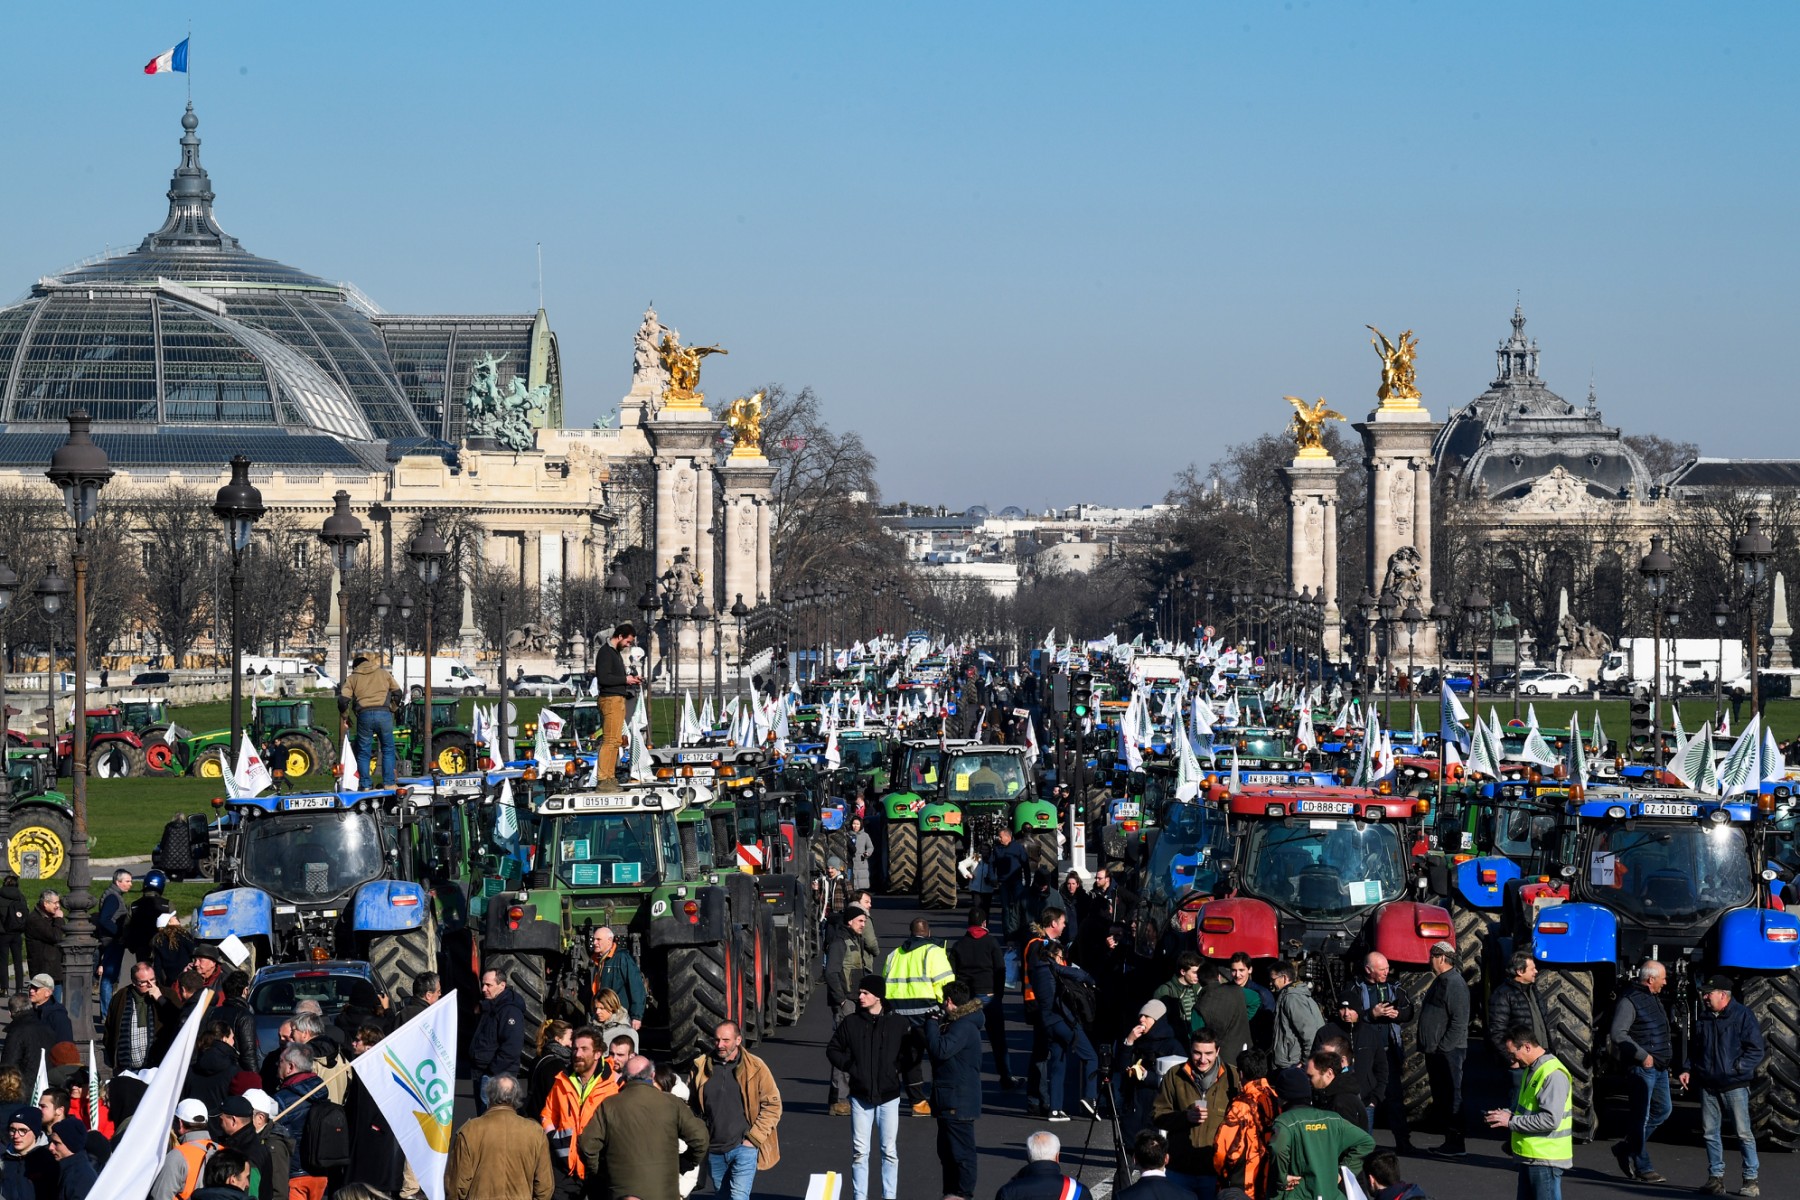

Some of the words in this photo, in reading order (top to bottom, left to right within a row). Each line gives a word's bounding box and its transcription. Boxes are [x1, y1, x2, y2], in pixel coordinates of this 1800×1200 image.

[585, 797, 609, 806] 01519
[614, 797, 624, 805] 77
[1302, 801, 1348, 813] CD-888-CE
[1644, 804, 1692, 815] CZ-210-CE
[1603, 868, 1614, 877] 77
[654, 902, 664, 914] 40
[415, 1058, 454, 1127] CGB
